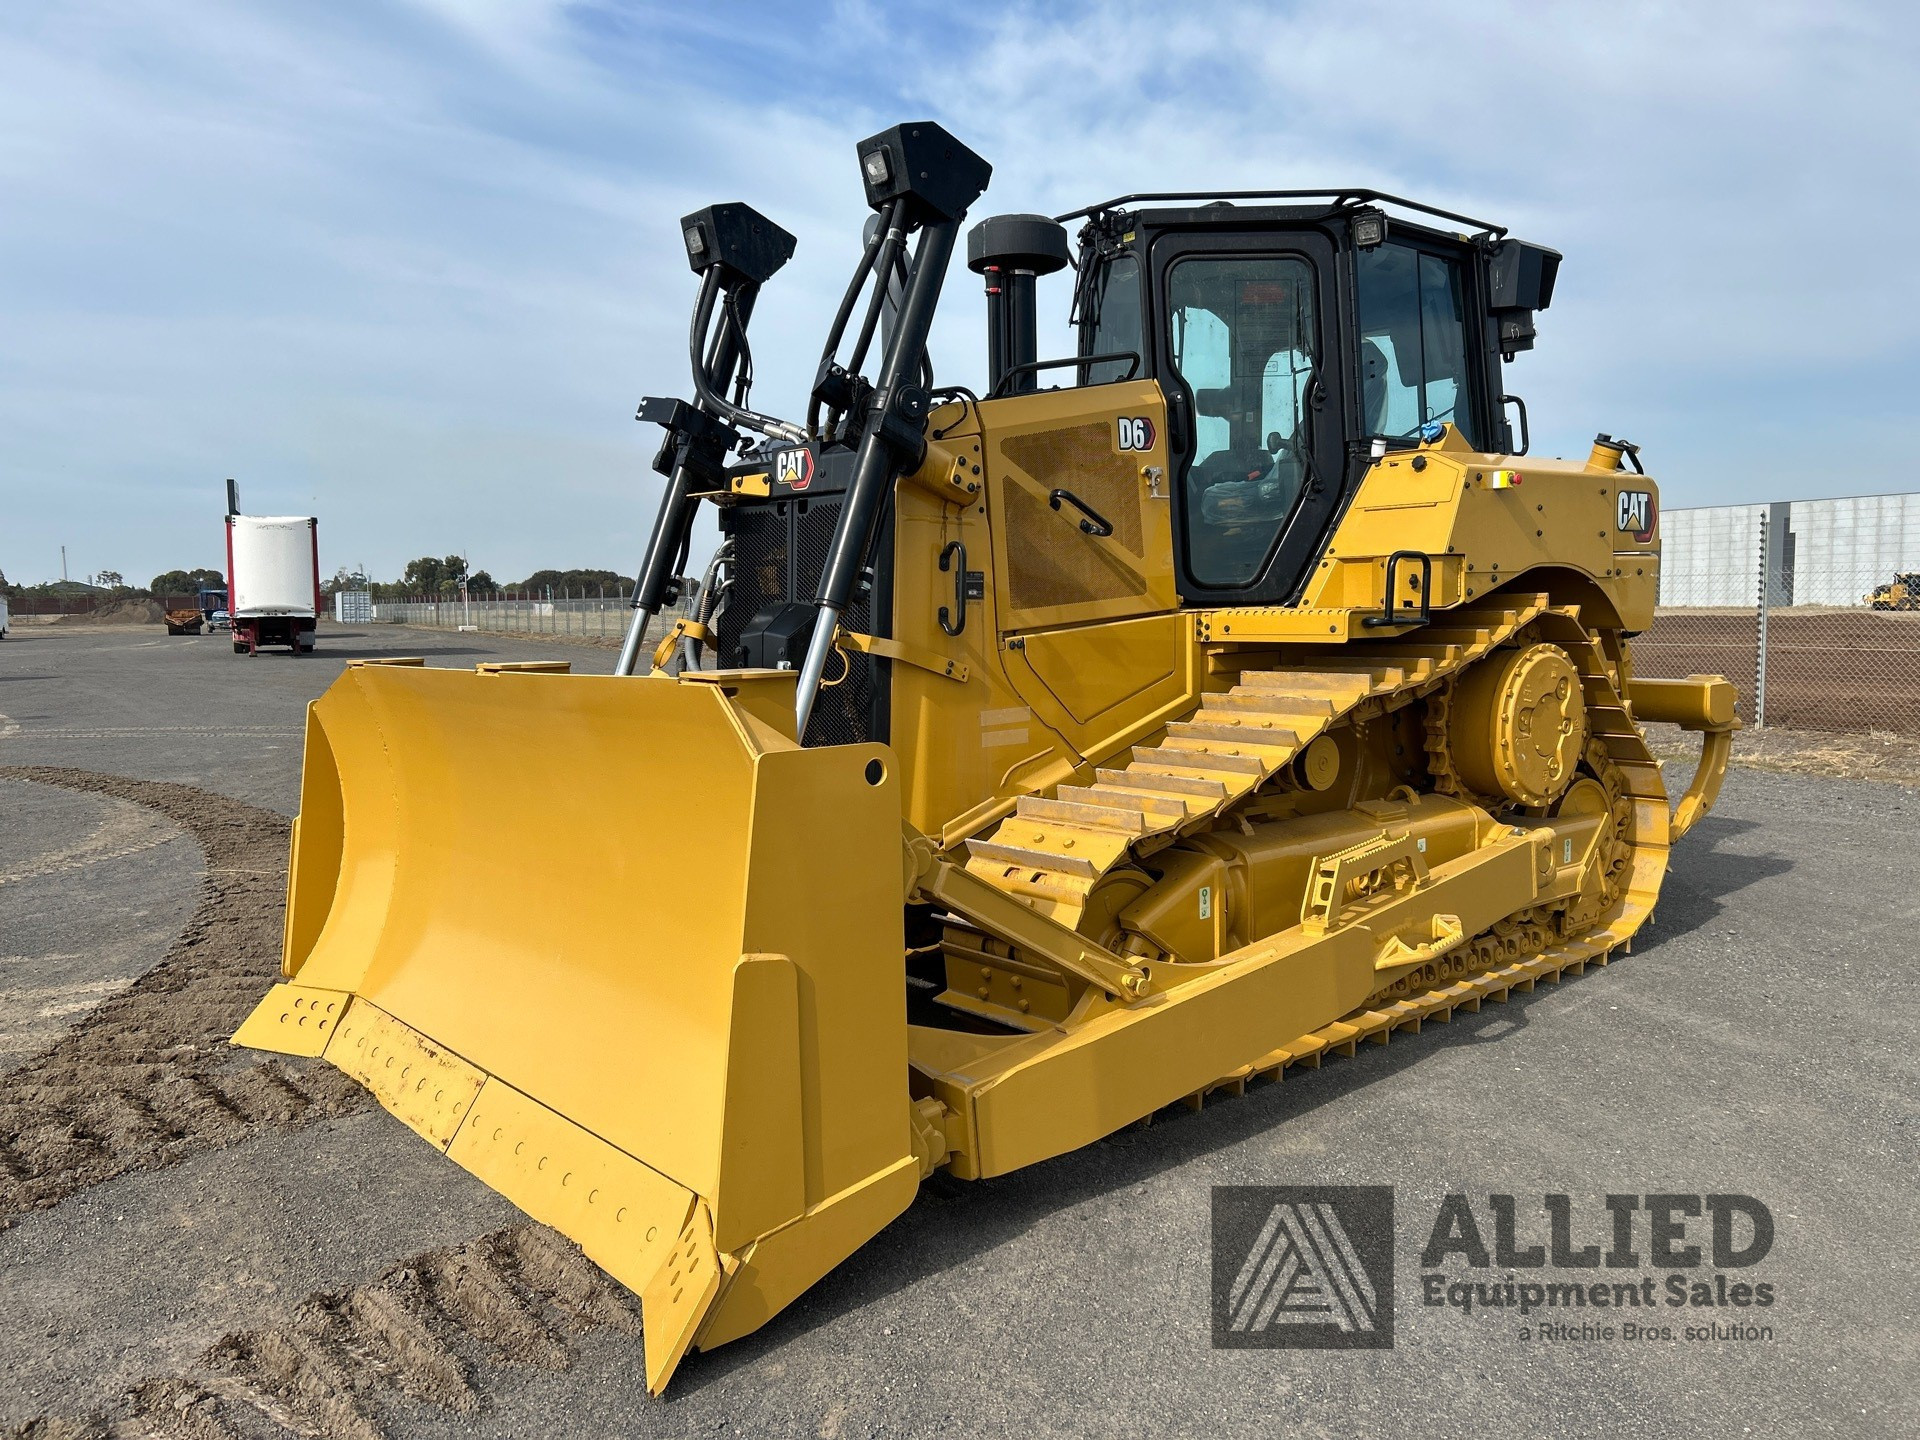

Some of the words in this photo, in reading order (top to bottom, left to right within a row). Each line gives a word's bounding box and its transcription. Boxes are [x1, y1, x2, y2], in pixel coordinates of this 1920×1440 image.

[1118, 418, 1145, 449] D6
[777, 450, 804, 482] CAT
[1617, 491, 1648, 531] CAT
